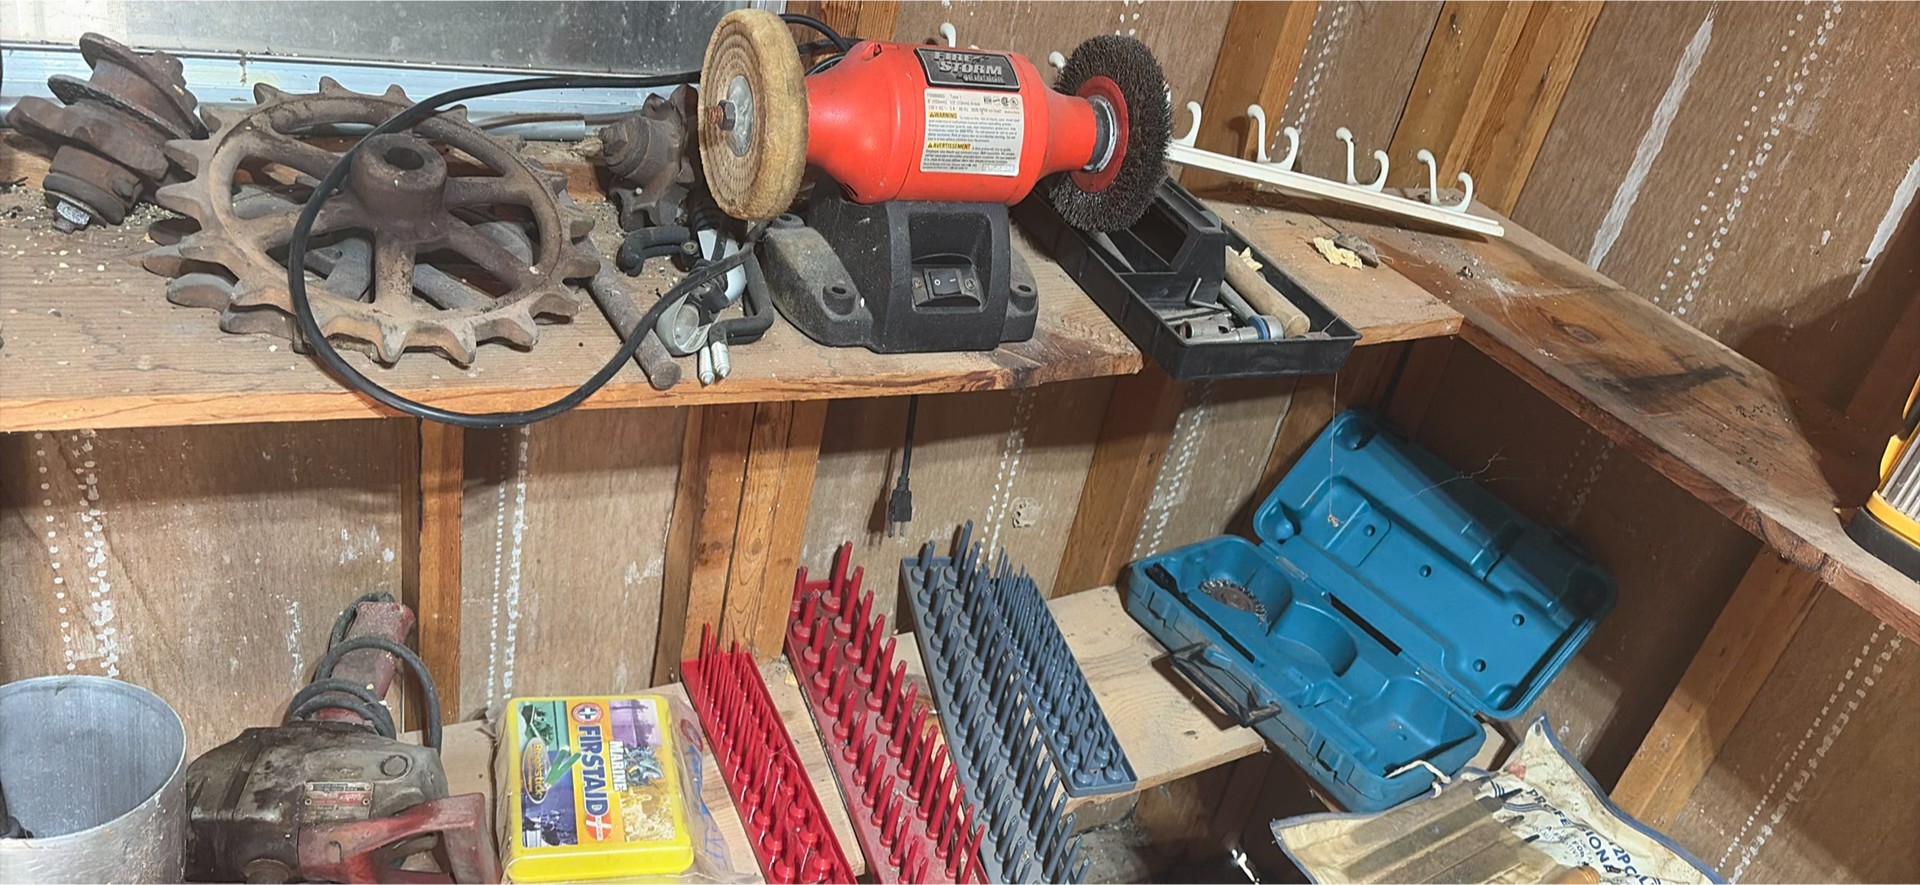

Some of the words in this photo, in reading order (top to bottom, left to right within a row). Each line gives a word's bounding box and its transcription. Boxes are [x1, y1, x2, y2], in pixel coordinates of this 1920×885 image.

[934, 51, 973, 63] FIRE
[939, 61, 1003, 76] STORM
[934, 112, 958, 120] WARNING
[609, 741, 628, 792] MARINE
